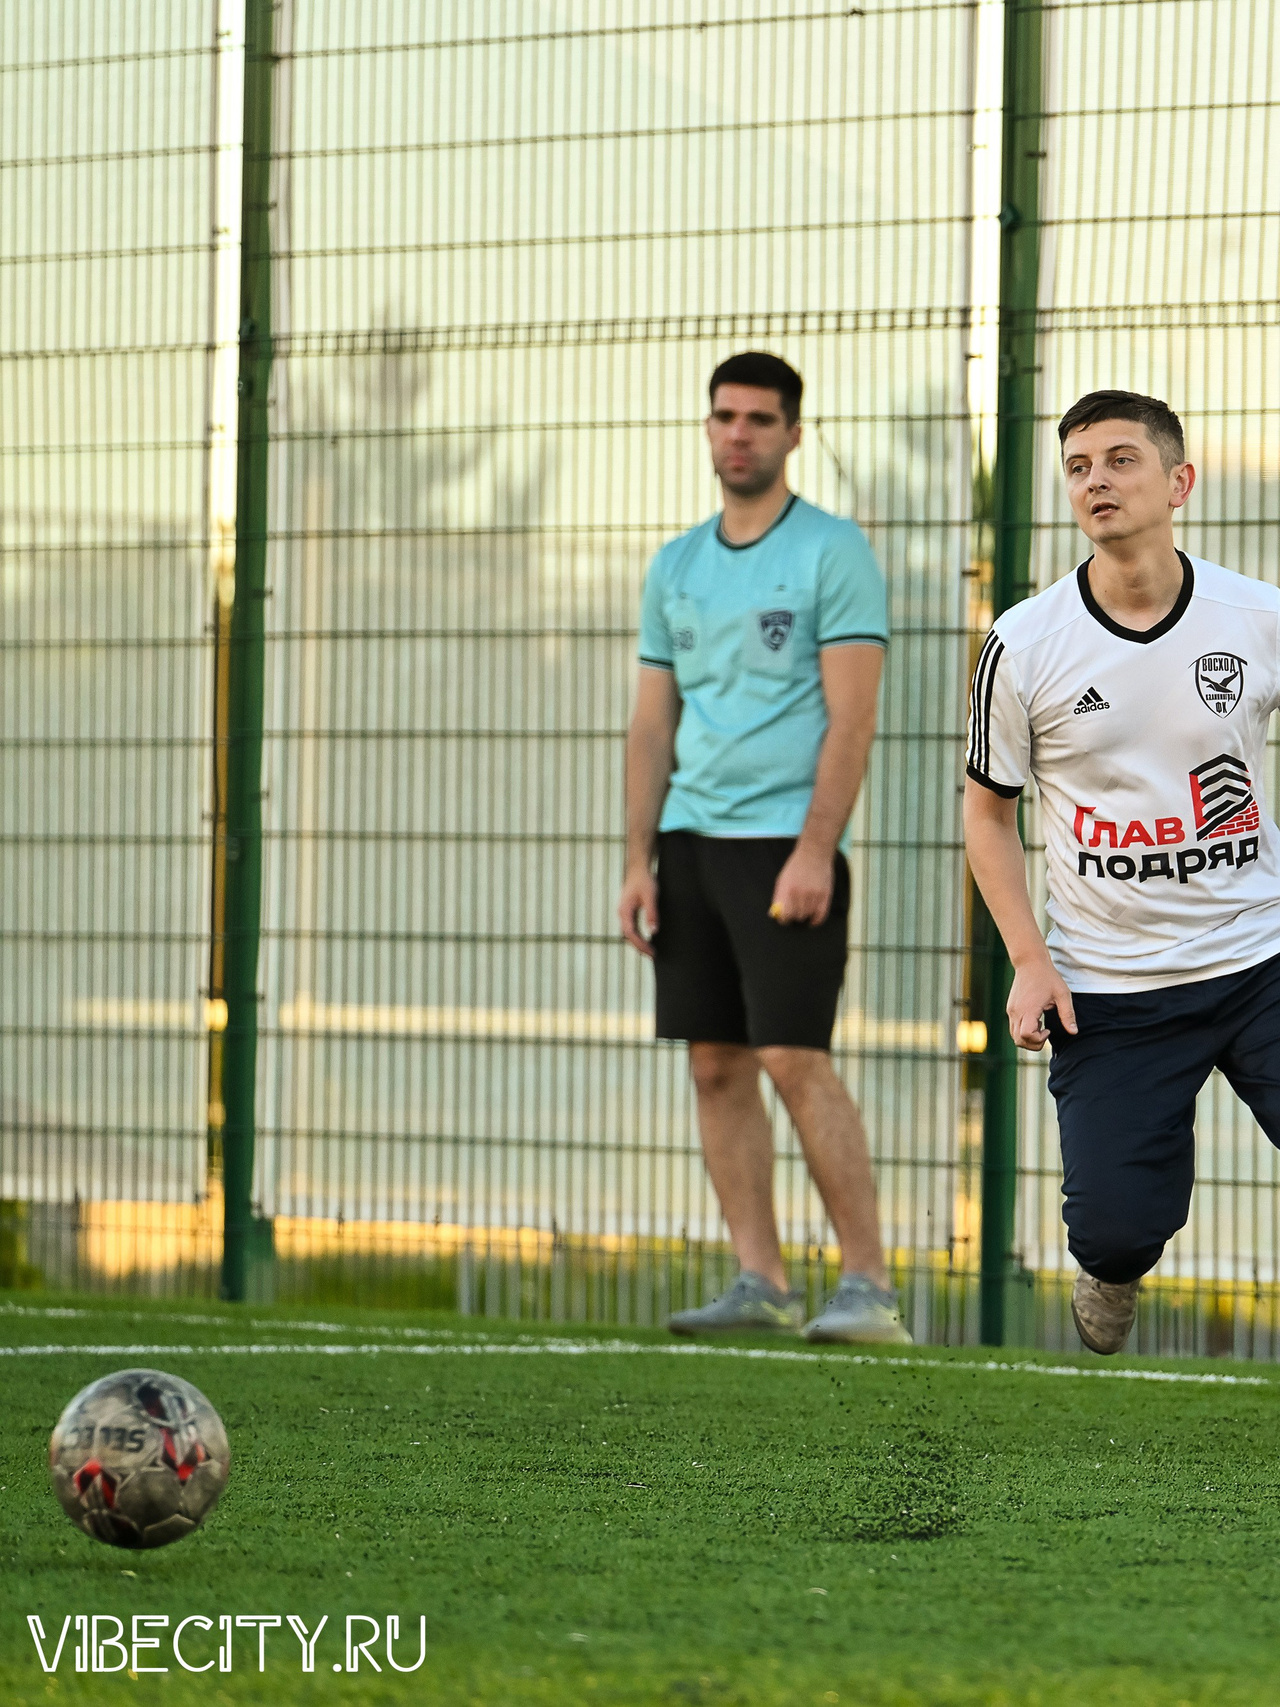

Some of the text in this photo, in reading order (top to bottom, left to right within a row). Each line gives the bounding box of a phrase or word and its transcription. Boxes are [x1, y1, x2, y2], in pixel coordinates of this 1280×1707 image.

[1202, 657, 1237, 674] ВОСХОД
[1073, 701, 1111, 715] adidas
[1215, 701, 1228, 713] ФК
